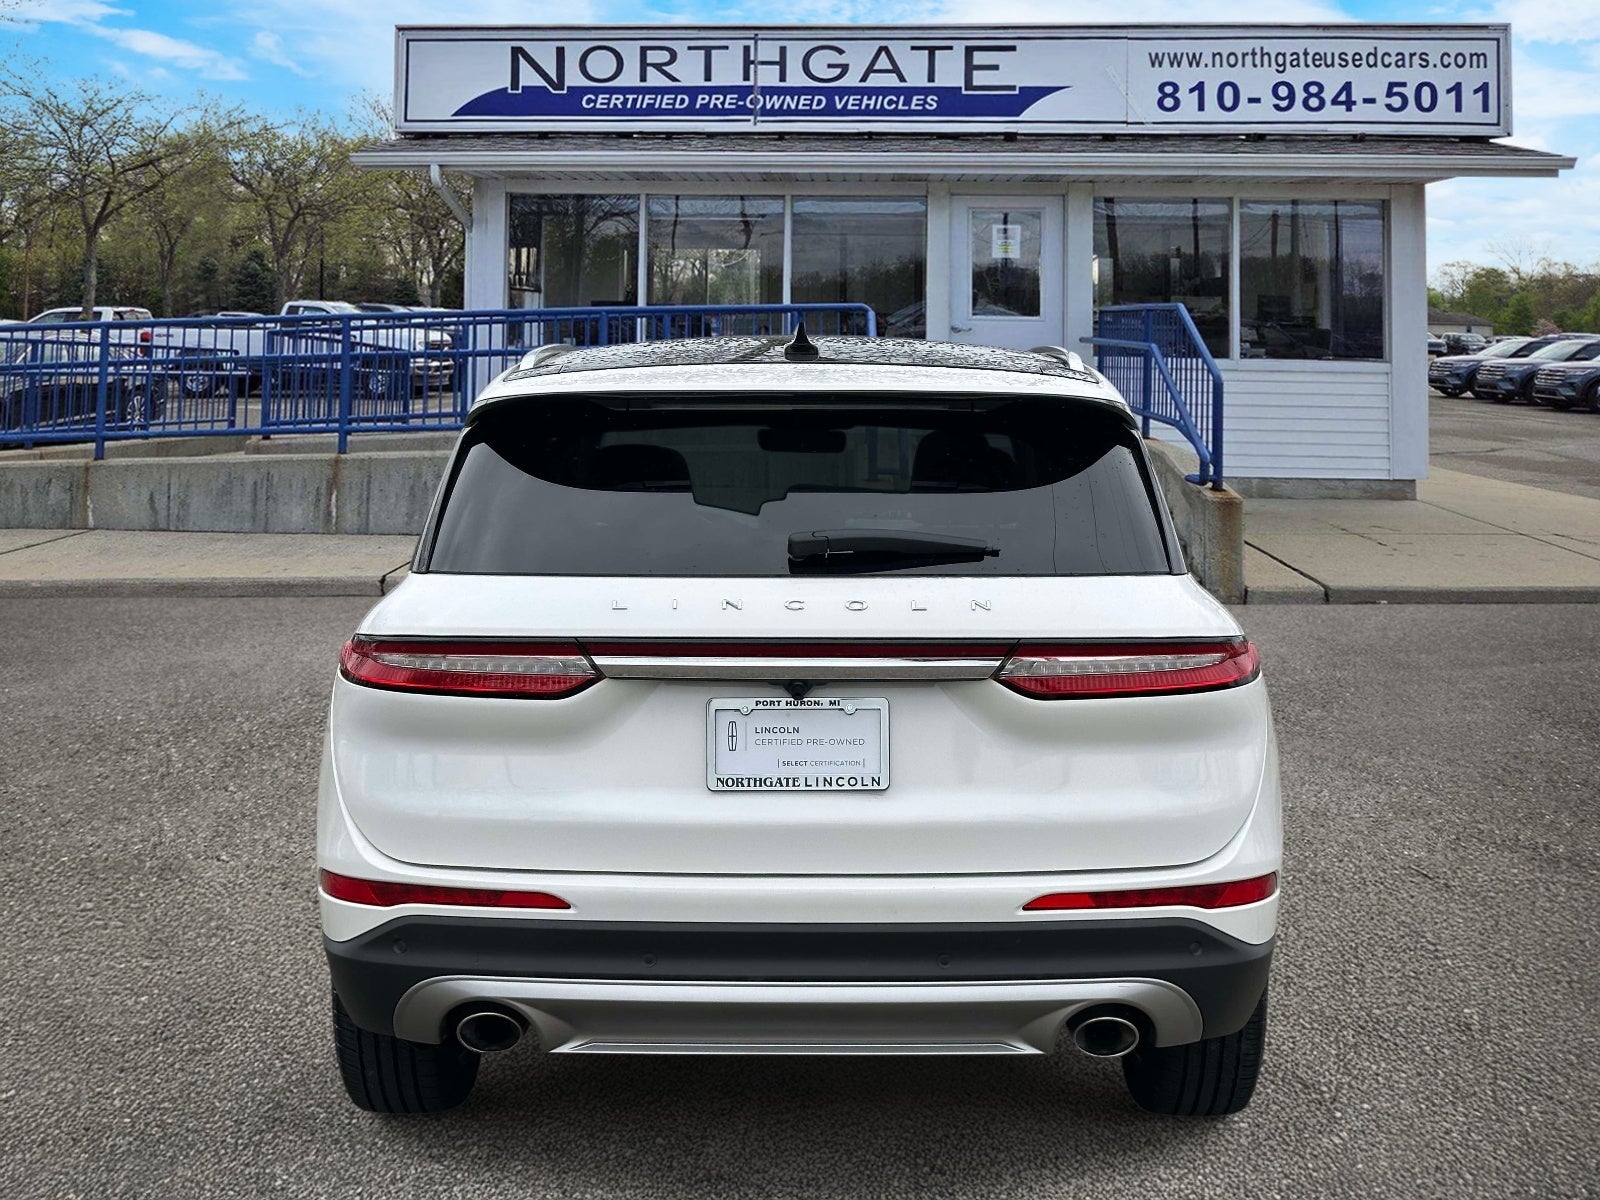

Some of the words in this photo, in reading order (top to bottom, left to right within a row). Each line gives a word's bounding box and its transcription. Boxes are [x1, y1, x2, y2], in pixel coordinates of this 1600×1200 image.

[508, 44, 1018, 94] NORTHGATE
[1147, 50, 1489, 74] www.northgateusedcars.com
[581, 94, 690, 111] CERTIFIED
[694, 94, 827, 111] PRE-OWNED
[833, 95, 939, 111] VEHICLES
[1156, 80, 1490, 114] 810-984-5011
[611, 599, 992, 611] LINCOLN
[754, 726, 800, 734] LINCOLN
[754, 738, 803, 746] CERTIFIED
[806, 738, 865, 746] PRE-OWNED
[716, 776, 800, 788] NORTHGATE
[804, 776, 881, 787] LINCOLN
